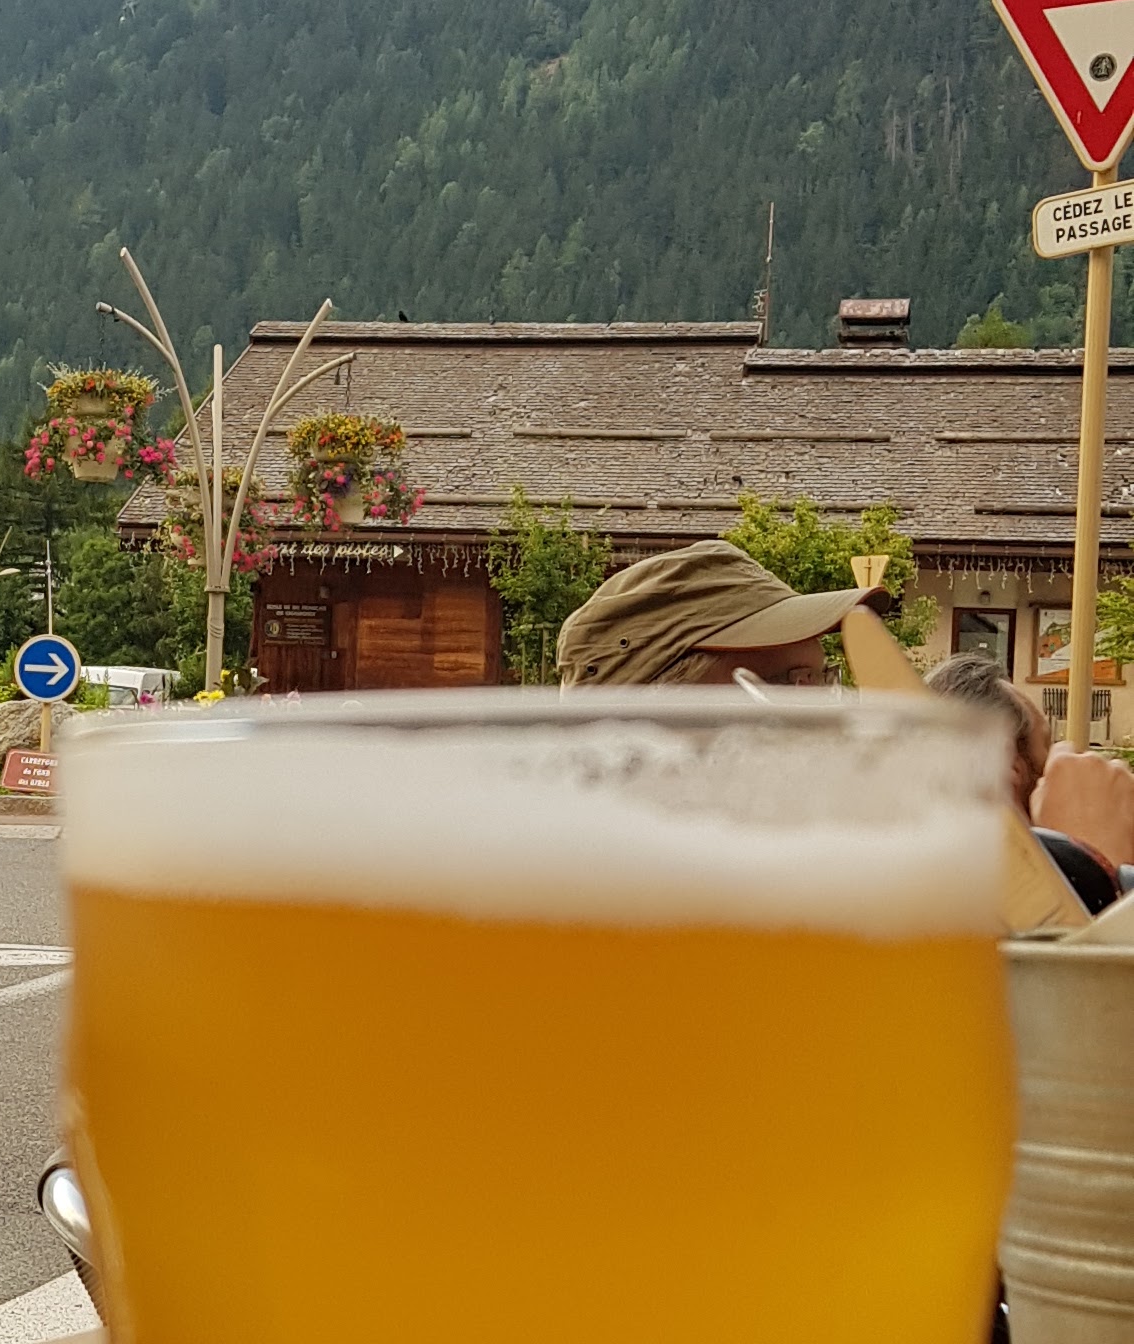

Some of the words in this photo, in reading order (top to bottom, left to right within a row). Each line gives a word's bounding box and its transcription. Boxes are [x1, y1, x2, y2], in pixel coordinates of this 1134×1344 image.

[1053, 198, 1103, 221] CÉDEZ
[1114, 192, 1133, 209] LE
[1056, 214, 1132, 243] PASSAGE
